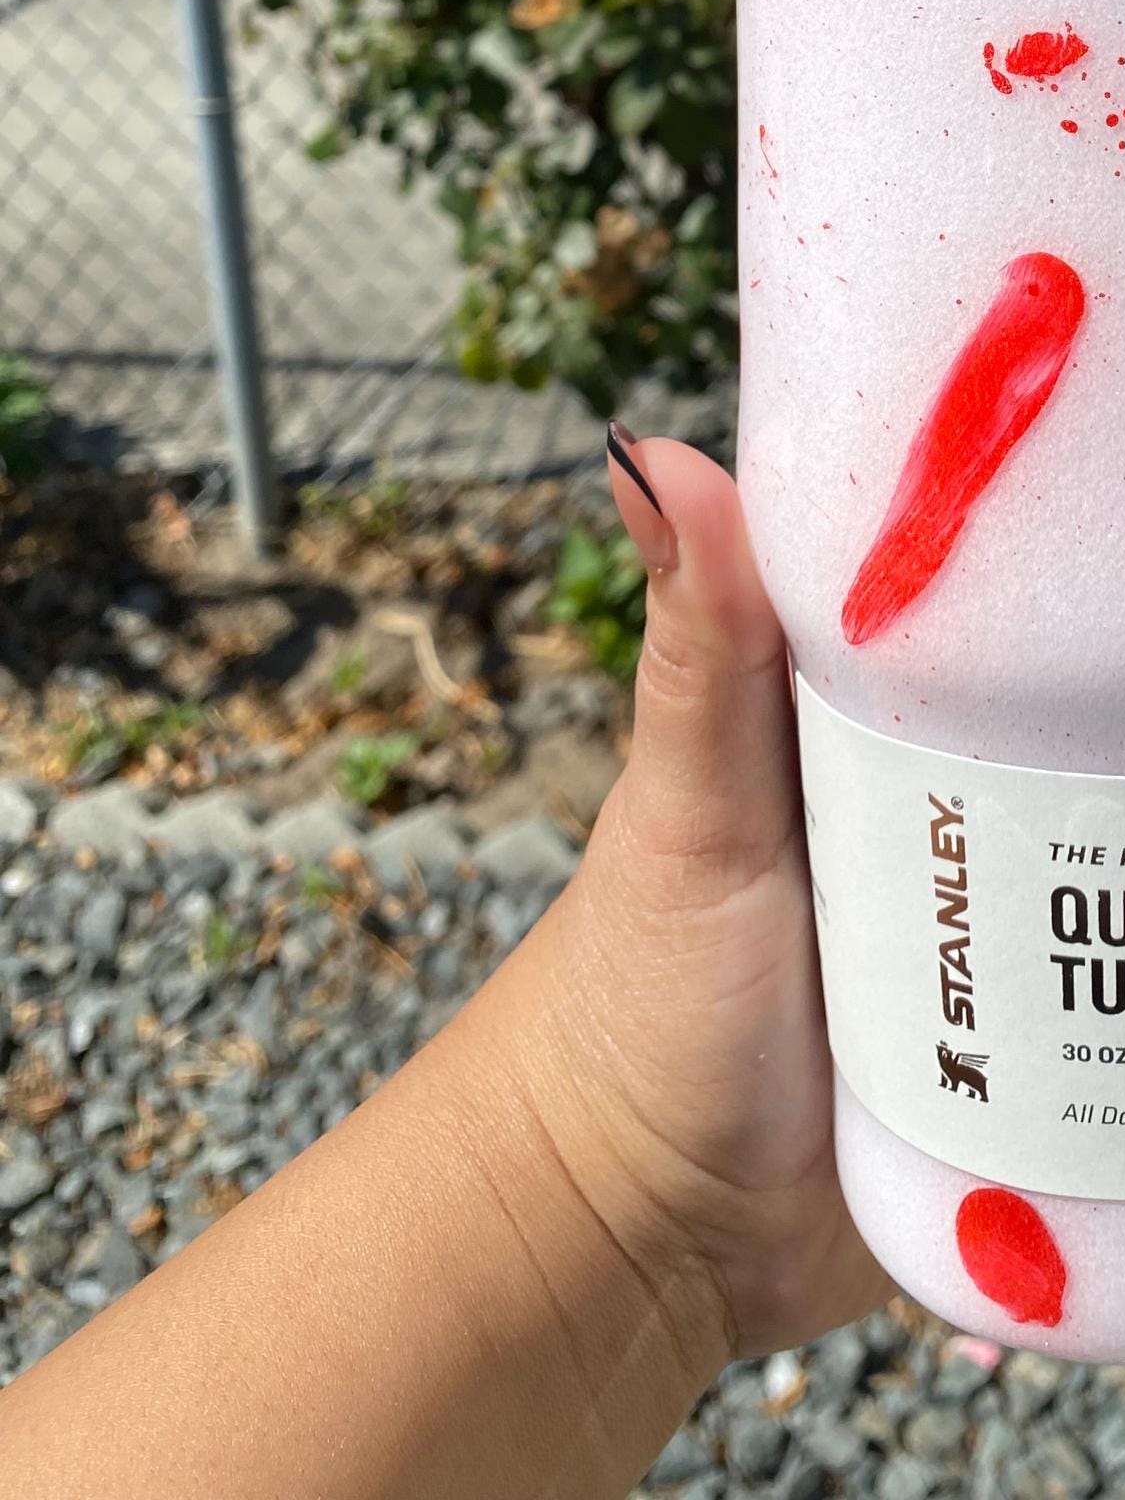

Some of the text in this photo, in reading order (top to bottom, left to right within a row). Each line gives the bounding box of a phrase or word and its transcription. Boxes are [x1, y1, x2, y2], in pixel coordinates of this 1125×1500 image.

[1048, 841, 1107, 867] THE
[1061, 1043, 1092, 1063] 30
[1061, 1102, 1095, 1124] All
